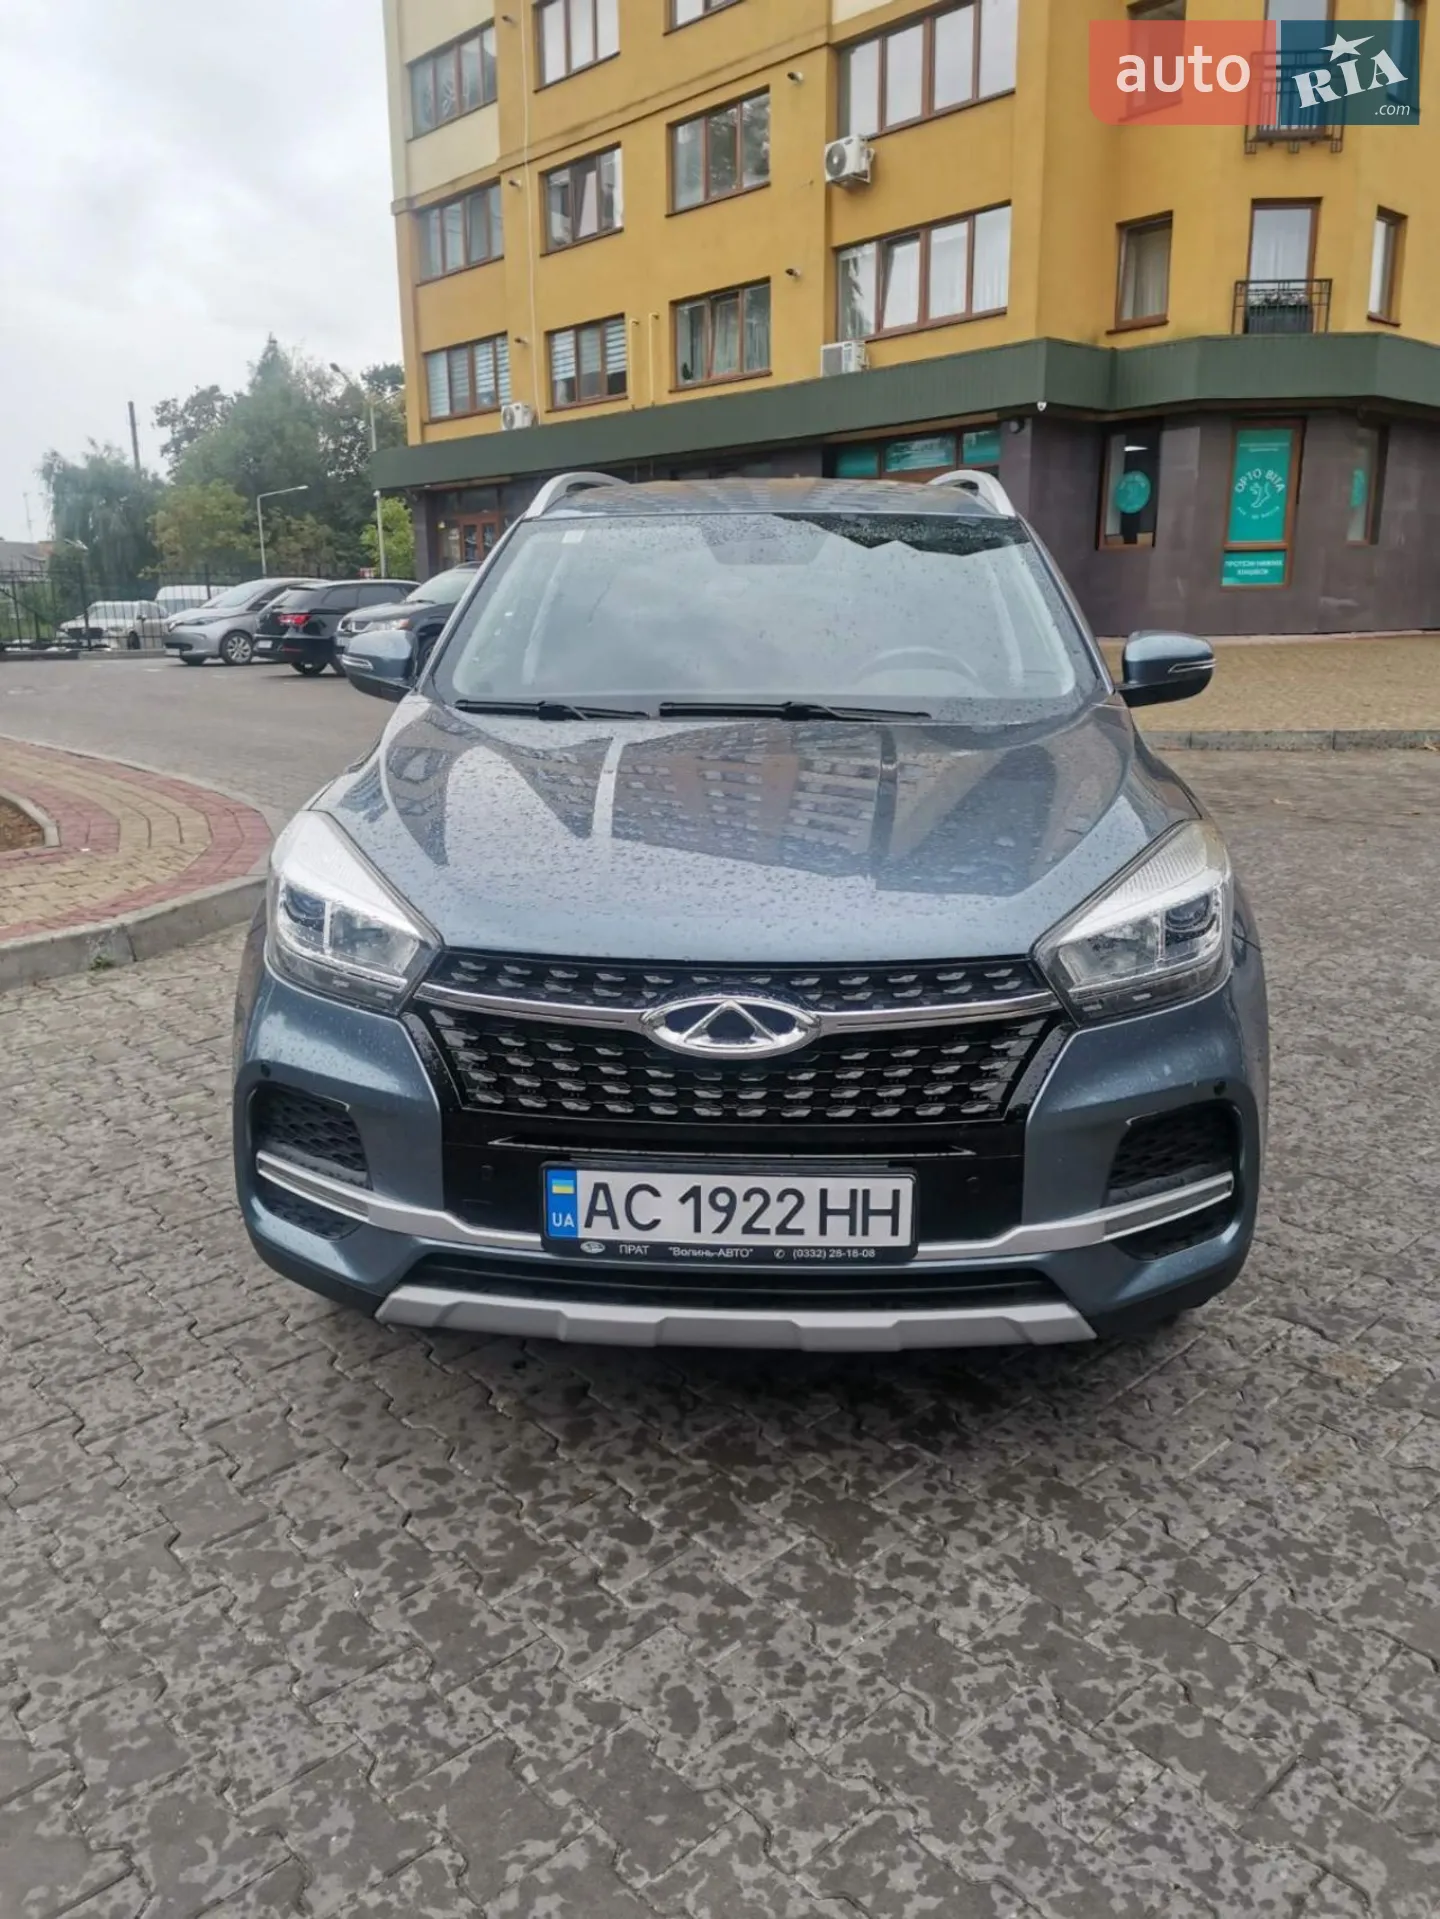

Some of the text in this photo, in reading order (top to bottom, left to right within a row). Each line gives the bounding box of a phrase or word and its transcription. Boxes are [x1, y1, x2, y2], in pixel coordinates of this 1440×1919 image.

[584, 1181, 901, 1237] AC 1922 HH
[552, 1211, 575, 1228] UA
[619, 1244, 650, 1256] ПРАТ
